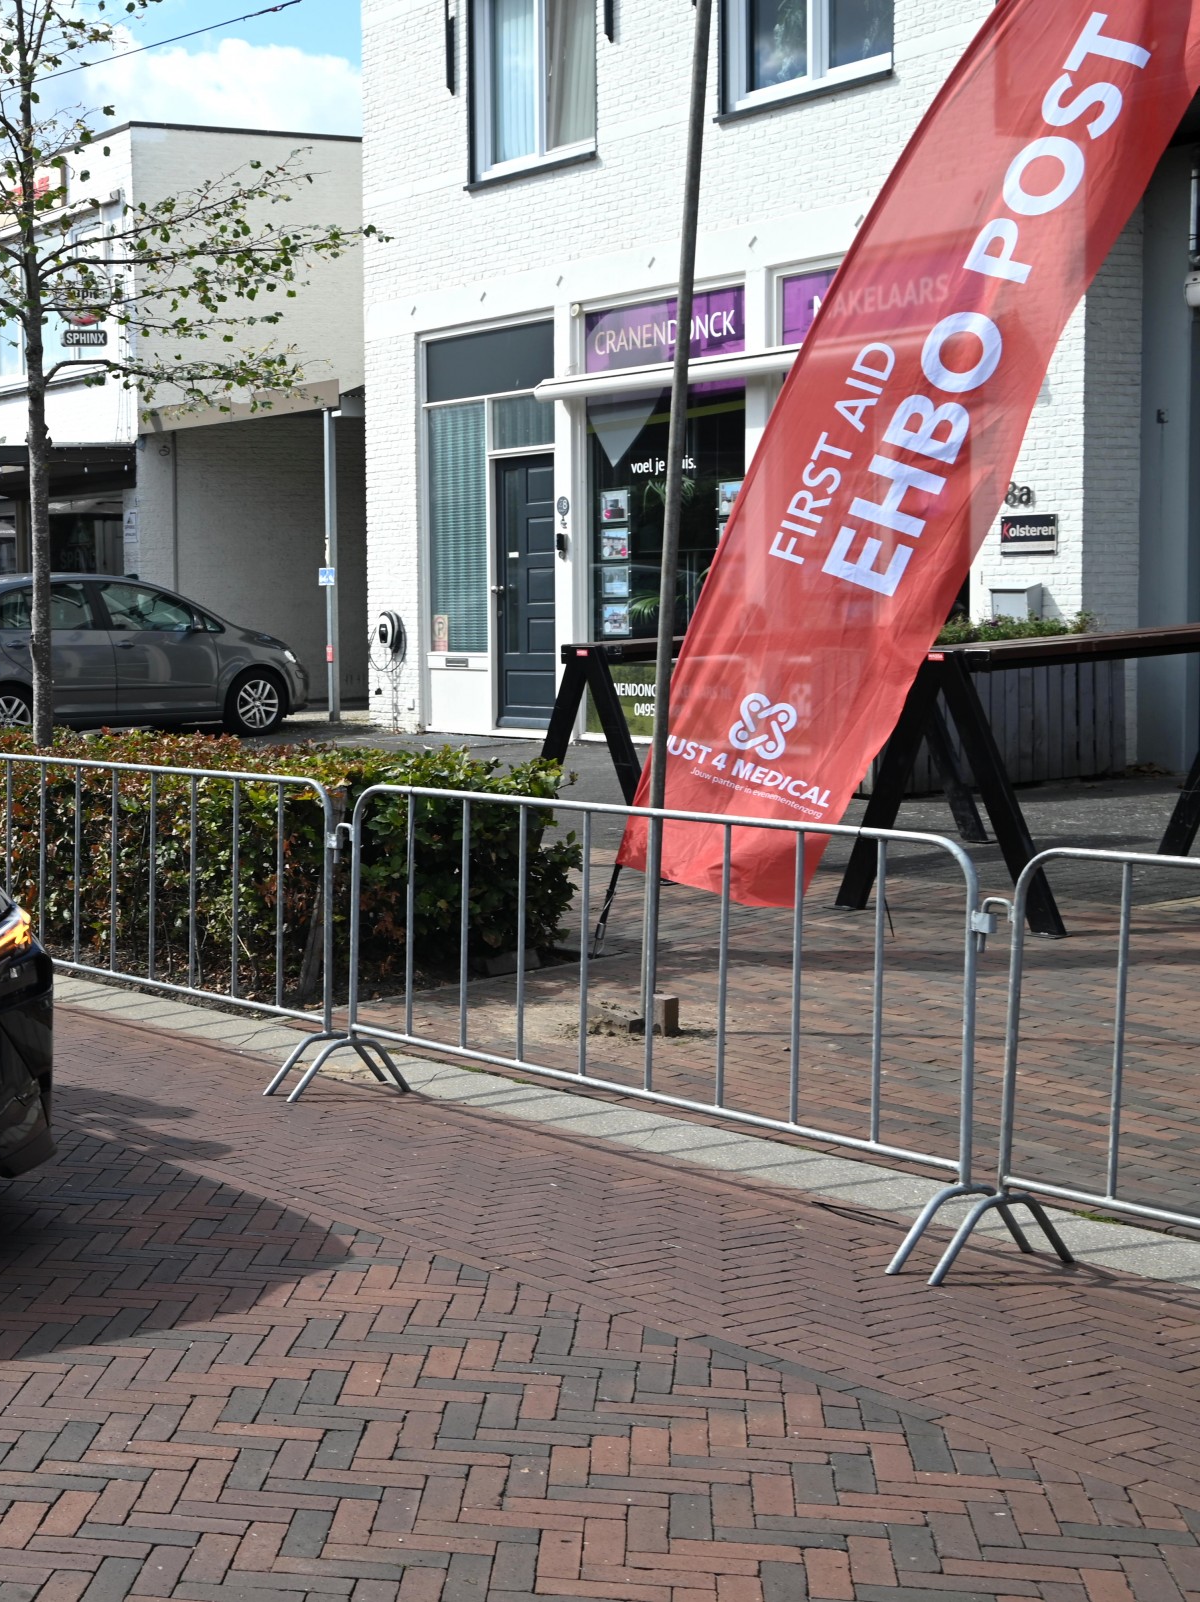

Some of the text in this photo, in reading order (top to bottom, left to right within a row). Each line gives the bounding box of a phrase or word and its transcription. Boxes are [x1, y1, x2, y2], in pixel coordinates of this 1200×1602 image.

[962, 11, 1151, 284] POST
[66, 332, 105, 344] SPHINX
[631, 458, 653, 473] voel
[655, 457, 665, 475] je
[768, 342, 896, 565] FIRST AID
[821, 311, 1003, 597] EHBO
[1005, 482, 1031, 504] 8a
[1003, 523, 1055, 539] Kolsteren
[690, 767, 823, 819] Jouw partner in evenementenzorg
[711, 753, 728, 771] 4
[731, 759, 831, 808] MEDICAL
